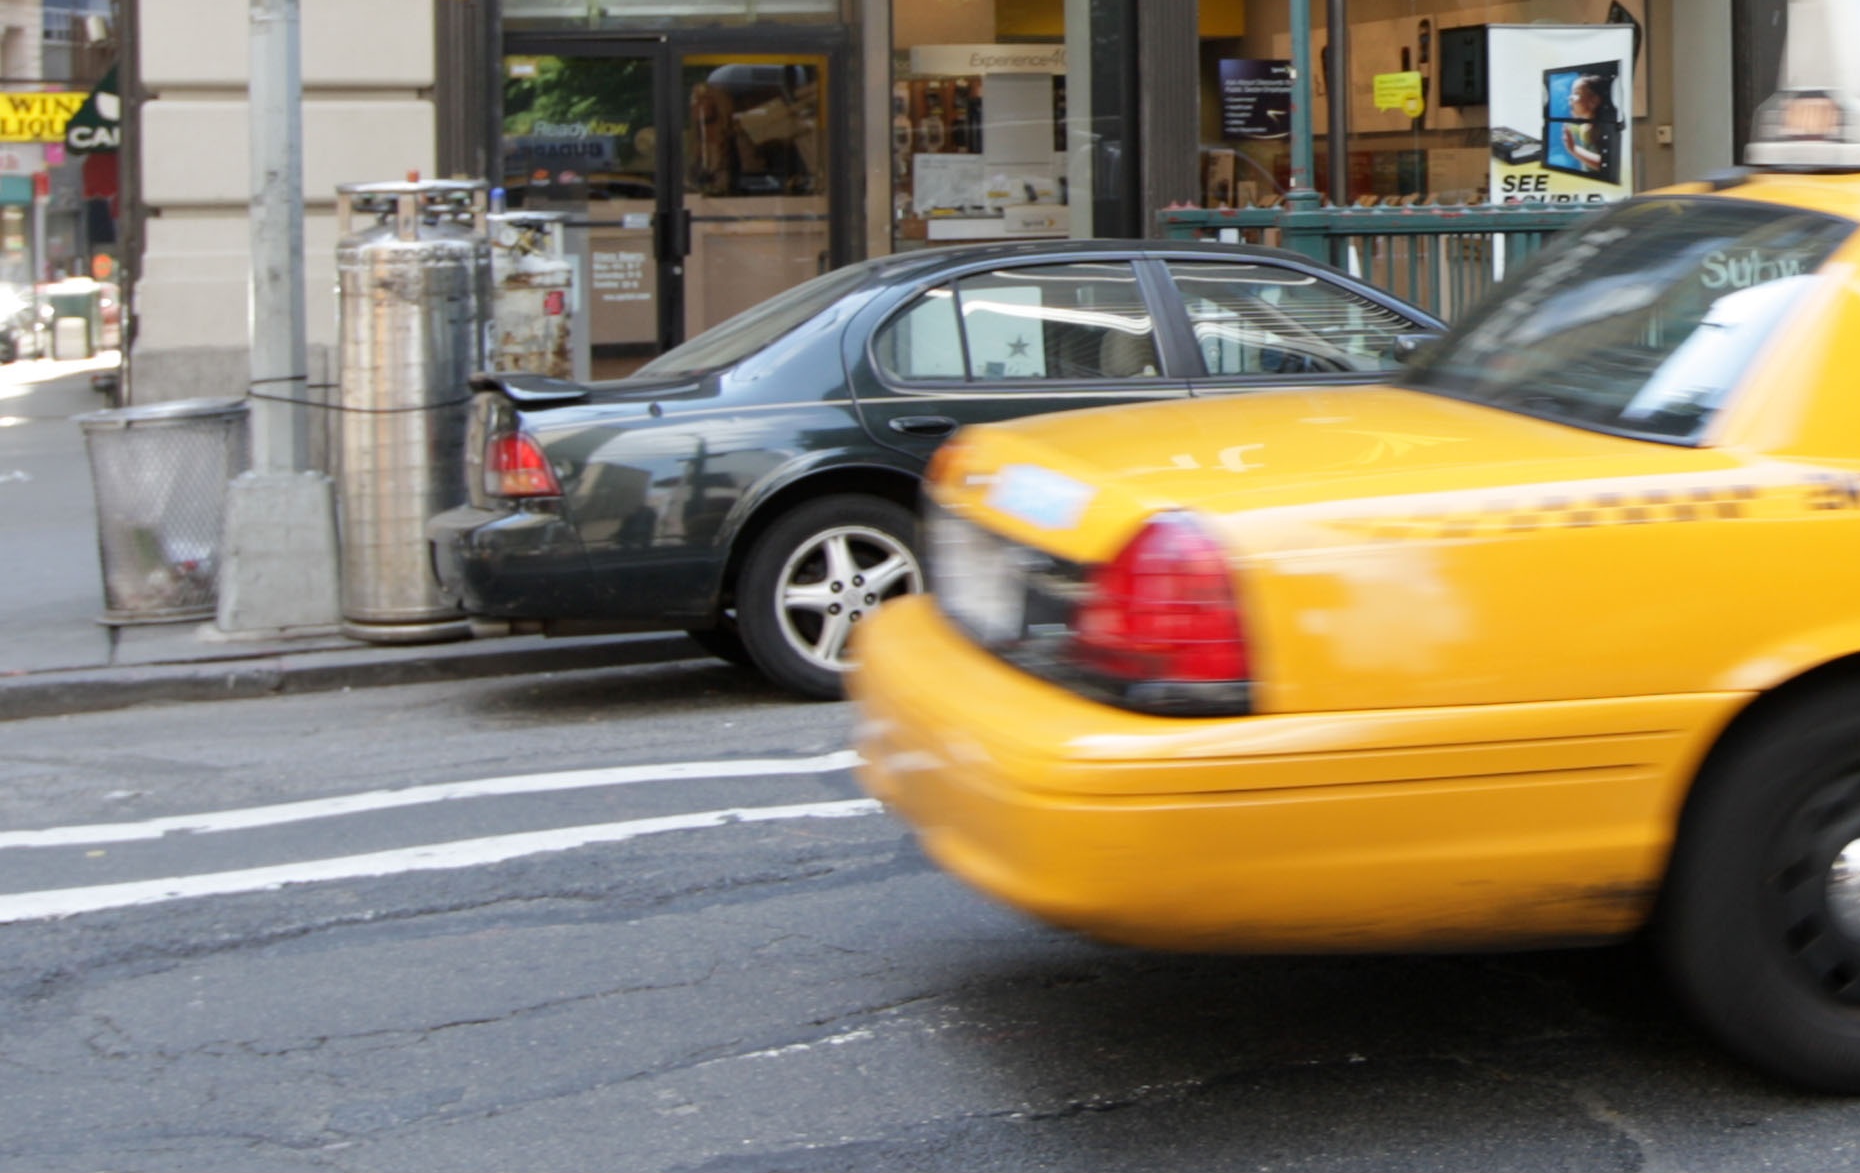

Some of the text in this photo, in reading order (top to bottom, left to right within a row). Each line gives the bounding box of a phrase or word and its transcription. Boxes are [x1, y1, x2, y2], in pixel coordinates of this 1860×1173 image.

[9, 95, 87, 115] WIN
[1502, 174, 1549, 192] SEE
[1700, 249, 1803, 289] Subw
